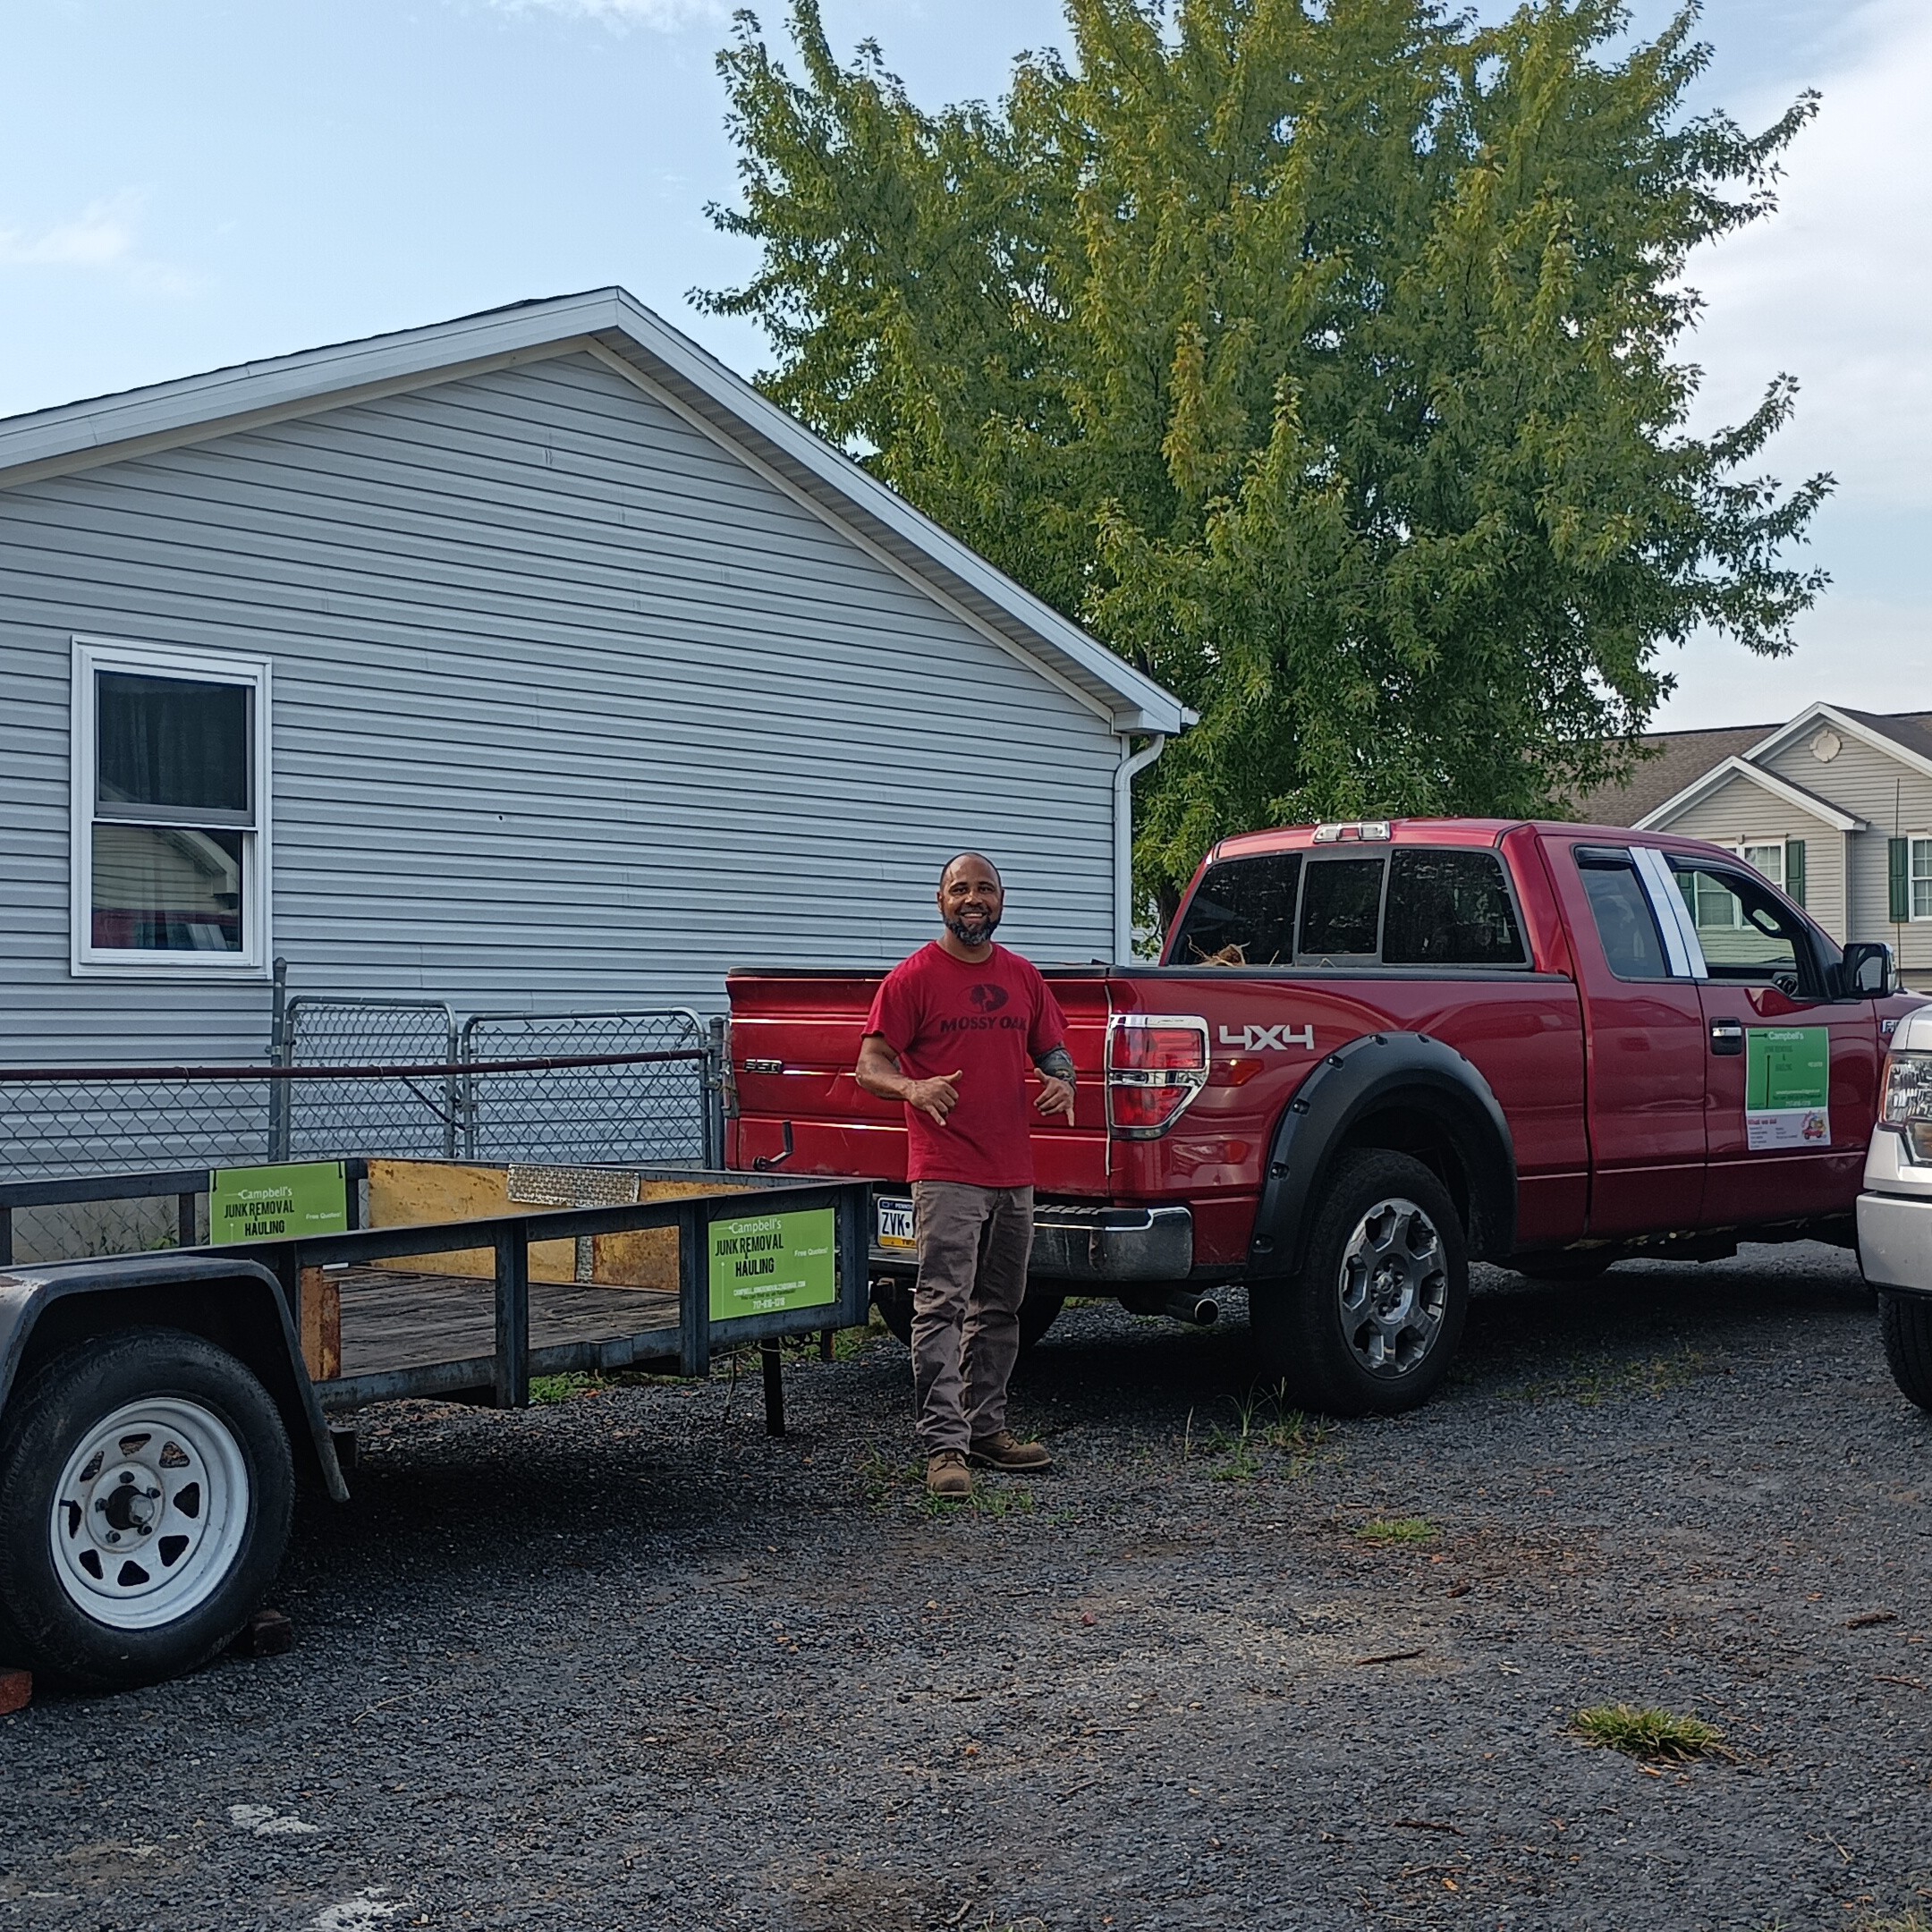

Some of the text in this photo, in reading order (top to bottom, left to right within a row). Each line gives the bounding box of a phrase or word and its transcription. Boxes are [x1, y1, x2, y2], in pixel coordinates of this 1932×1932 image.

[941, 1015, 1027, 1032] MOSSY OAK
[1219, 1025, 1314, 1050] 4X4
[242, 1187, 292, 1199] Campbell's
[225, 1199, 294, 1218] JUNK REMOVAL
[245, 1220, 284, 1236] HAULING
[731, 1218, 782, 1233] Campbell's
[715, 1233, 784, 1256] JUNK REMOVAL
[735, 1257, 775, 1277] HAULING
